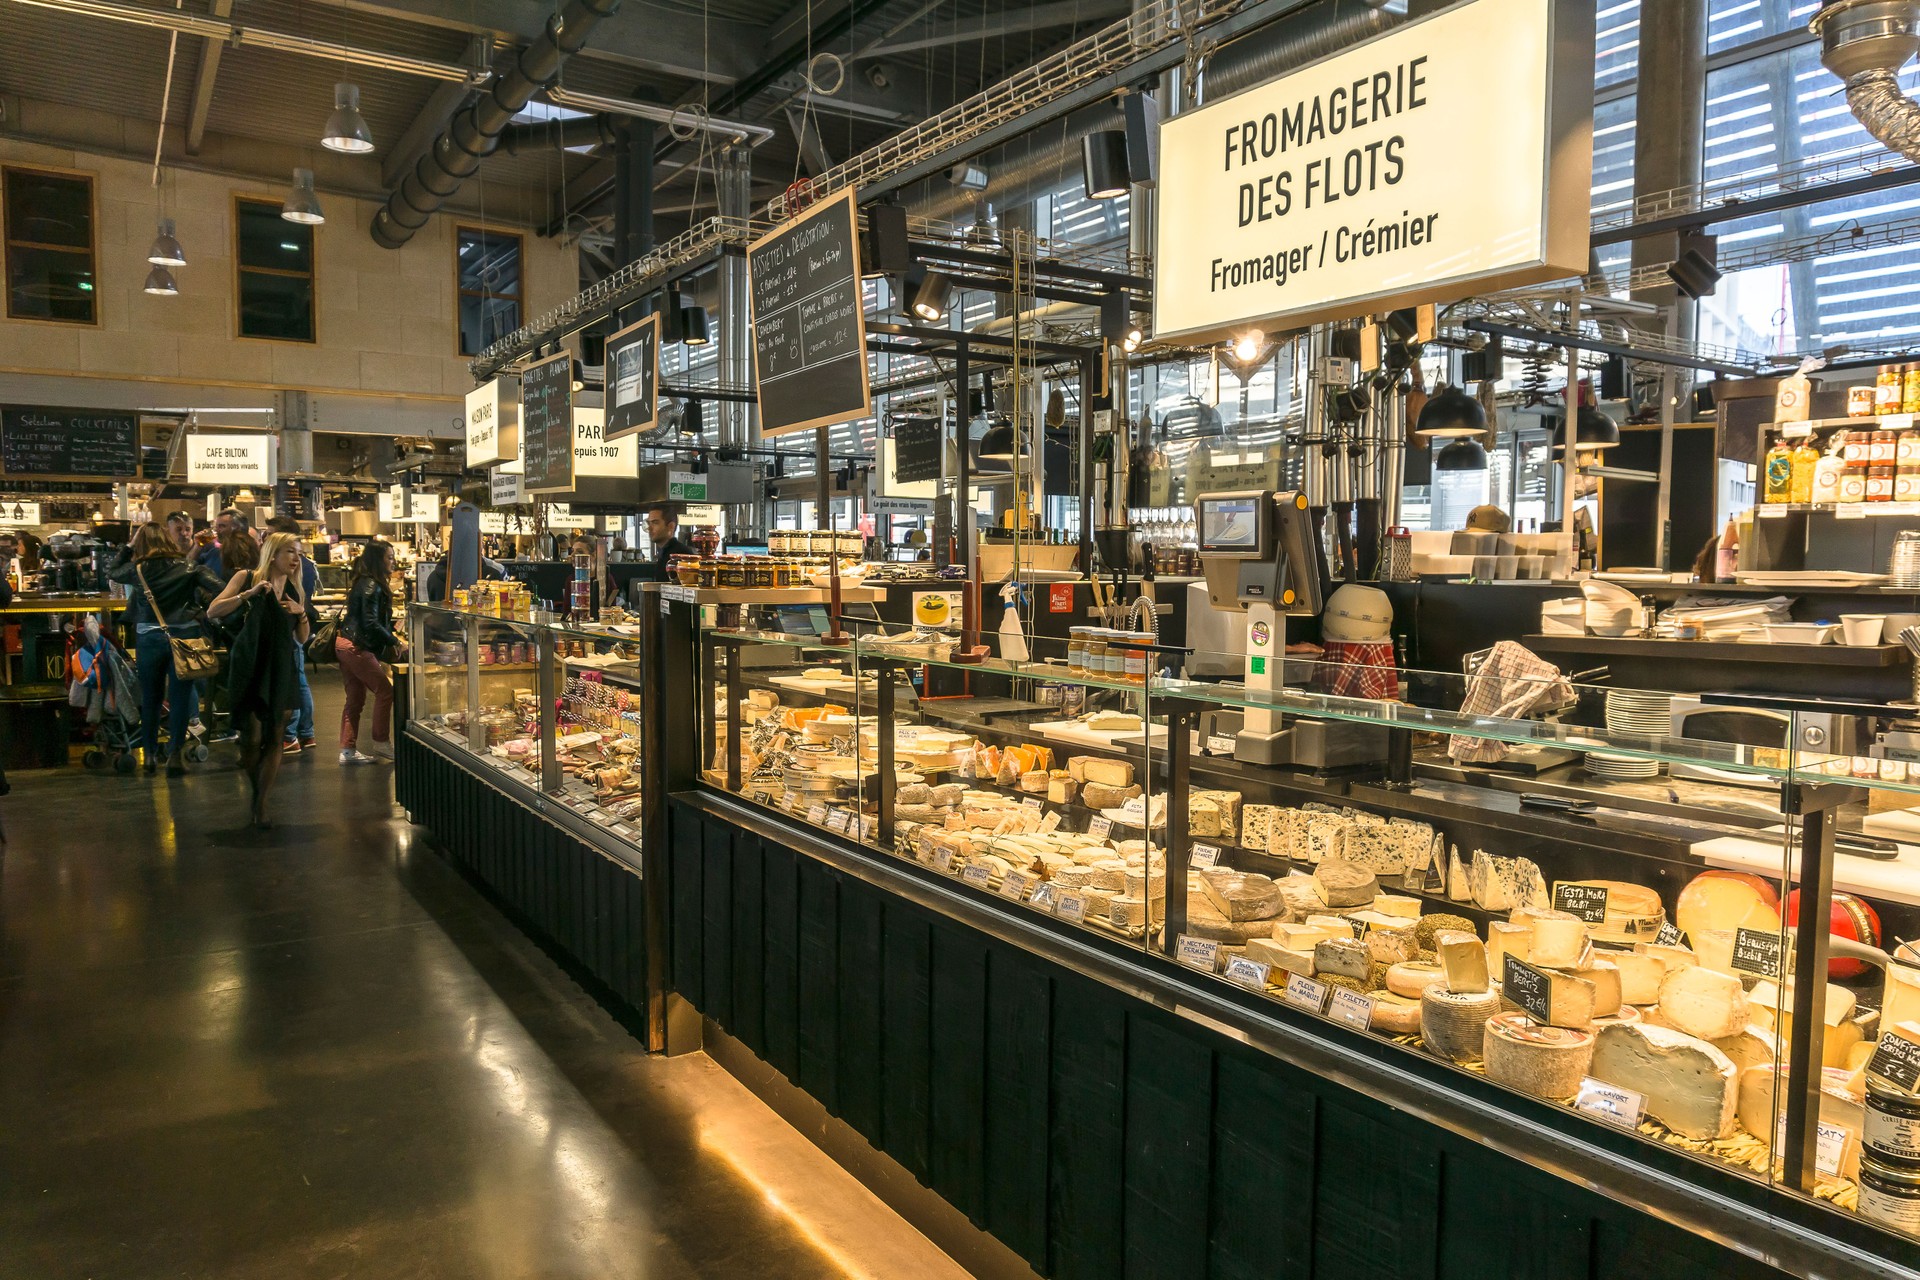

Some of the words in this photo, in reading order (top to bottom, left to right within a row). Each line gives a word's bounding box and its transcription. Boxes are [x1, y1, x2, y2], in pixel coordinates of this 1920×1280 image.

[1225, 55, 1428, 172] FROMAGERIE
[1238, 170, 1292, 228] DES
[1305, 134, 1405, 210] FLOTS
[1211, 243, 1313, 293] Fromager
[1336, 209, 1439, 264] Crémier
[757, 318, 784, 339] CAMEMBERT
[578, 425, 606, 440] PARI
[206, 448, 222, 457] CAFE
[225, 448, 248, 457] BILTOKI
[574, 447, 597, 459] epuis
[599, 446, 620, 458] 1907
[202, 462, 215, 470] place
[240, 462, 259, 470] vivants
[1558, 885, 1584, 898] TESTA
[1587, 887, 1606, 900] MORA
[1184, 947, 1210, 957] FERMIER
[1187, 941, 1216, 951] NECTAIRE
[1234, 967, 1259, 979] FERMIER
[1506, 957, 1541, 983] TOMMETTE
[1297, 980, 1315, 993] FLEUR
[1298, 989, 1320, 1002] MAQUIS
[1343, 993, 1370, 1008] FILETTA
[1603, 1090, 1630, 1104] LAVORT
[1881, 1116, 1903, 1125] CERISE
